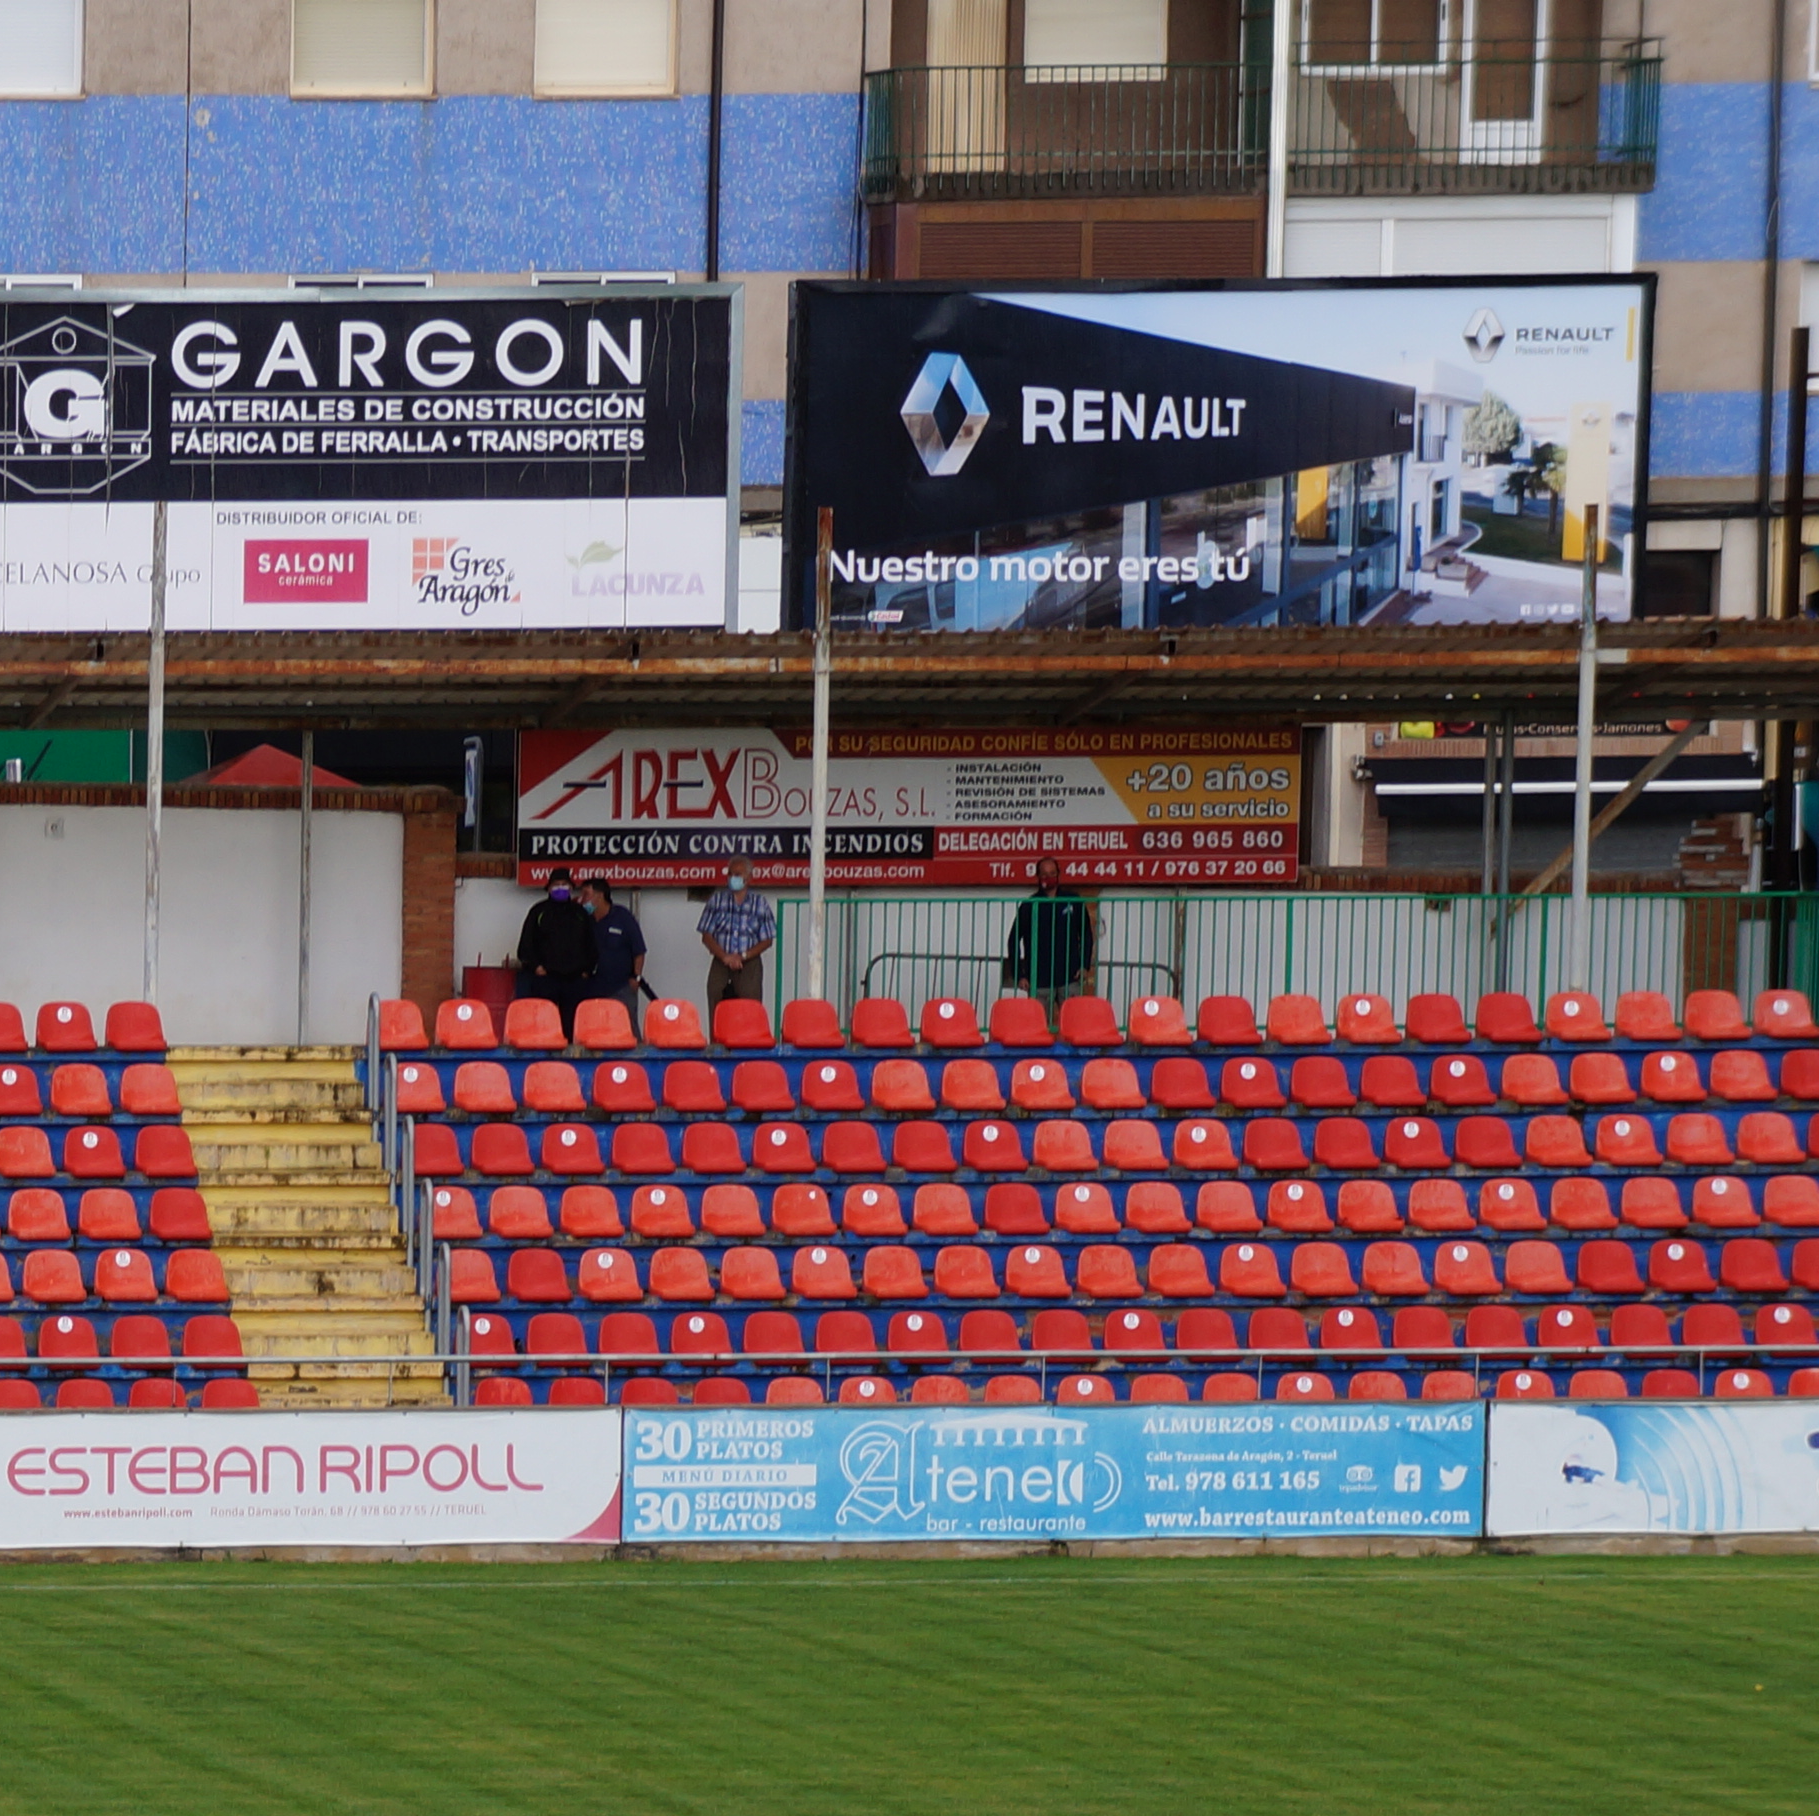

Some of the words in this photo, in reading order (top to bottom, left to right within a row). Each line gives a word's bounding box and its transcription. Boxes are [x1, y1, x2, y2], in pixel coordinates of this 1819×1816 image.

[1516, 327, 1615, 342] RENAULT
[171, 319, 643, 390] GARGON
[171, 397, 355, 423] MATERIALES
[364, 398, 403, 422] DE
[410, 393, 645, 421] CONSTRUCCIÓN
[1021, 385, 1247, 445] RENAULT
[171, 427, 276, 455] FÁBRICA
[283, 431, 314, 454] DE
[321, 430, 447, 454] FERRALLA
[467, 429, 644, 453] TRANSPORTES
[216, 511, 327, 526] DISTRIBUIDOR
[332, 511, 392, 525] OFICIAL
[257, 552, 355, 574] SALONI
[449, 547, 505, 580] Gres
[829, 549, 979, 584] Nuestro
[990, 552, 1109, 583] motor
[1118, 555, 1199, 583] eres
[1211, 547, 1250, 583] tú
[571, 572, 705, 597] LACUNZA
[417, 576, 511, 617] Aragón
[955, 761, 1042, 774] INSTALACIÓN
[1126, 762, 1193, 793] +20
[1204, 761, 1290, 792] años
[955, 774, 1064, 786] MANTENIMIENTO
[1168, 803, 1195, 818] su
[1201, 798, 1289, 818] servicio
[532, 829, 680, 856] PROTECCIÓN
[688, 833, 783, 855] CONTRA
[938, 829, 1039, 852] DELEGACIÓN
[1043, 831, 1064, 851] EN
[1068, 831, 1128, 851] TERUEL
[1142, 830, 1183, 849] 636
[1192, 830, 1234, 849] 965
[1242, 830, 1283, 848] 860
[1165, 861, 1200, 876] 976
[1142, 1417, 1274, 1434] ALMUERZOS
[1290, 1416, 1390, 1432] COMIDAS
[1406, 1415, 1473, 1432] TAPAS
[636, 1420, 692, 1460] 30
[697, 1420, 814, 1440] PRIMEROS
[697, 1441, 783, 1460] PLATOS
[1146, 1451, 1174, 1462] Calle
[1176, 1451, 1225, 1462] Tarazona
[7, 1445, 304, 1497] ESTEBAN
[320, 1443, 544, 1493] RIPOLL
[722, 1469, 787, 1484] DIARIO
[1145, 1473, 1180, 1491] Tel.
[1185, 1471, 1226, 1490] 978
[1232, 1471, 1273, 1490] 611
[1279, 1470, 1320, 1490] 165
[63, 1507, 193, 1520] www.estebanripoll.com
[210, 1506, 249, 1518] Ronda
[634, 1492, 691, 1532] 30
[694, 1491, 816, 1511] SEGUNDOS
[694, 1512, 781, 1532] PLATOS
[1144, 1507, 1470, 1527] www.barrestauranteateneo.com
[926, 1515, 958, 1532] bar
[980, 1515, 1086, 1532] restaurante
